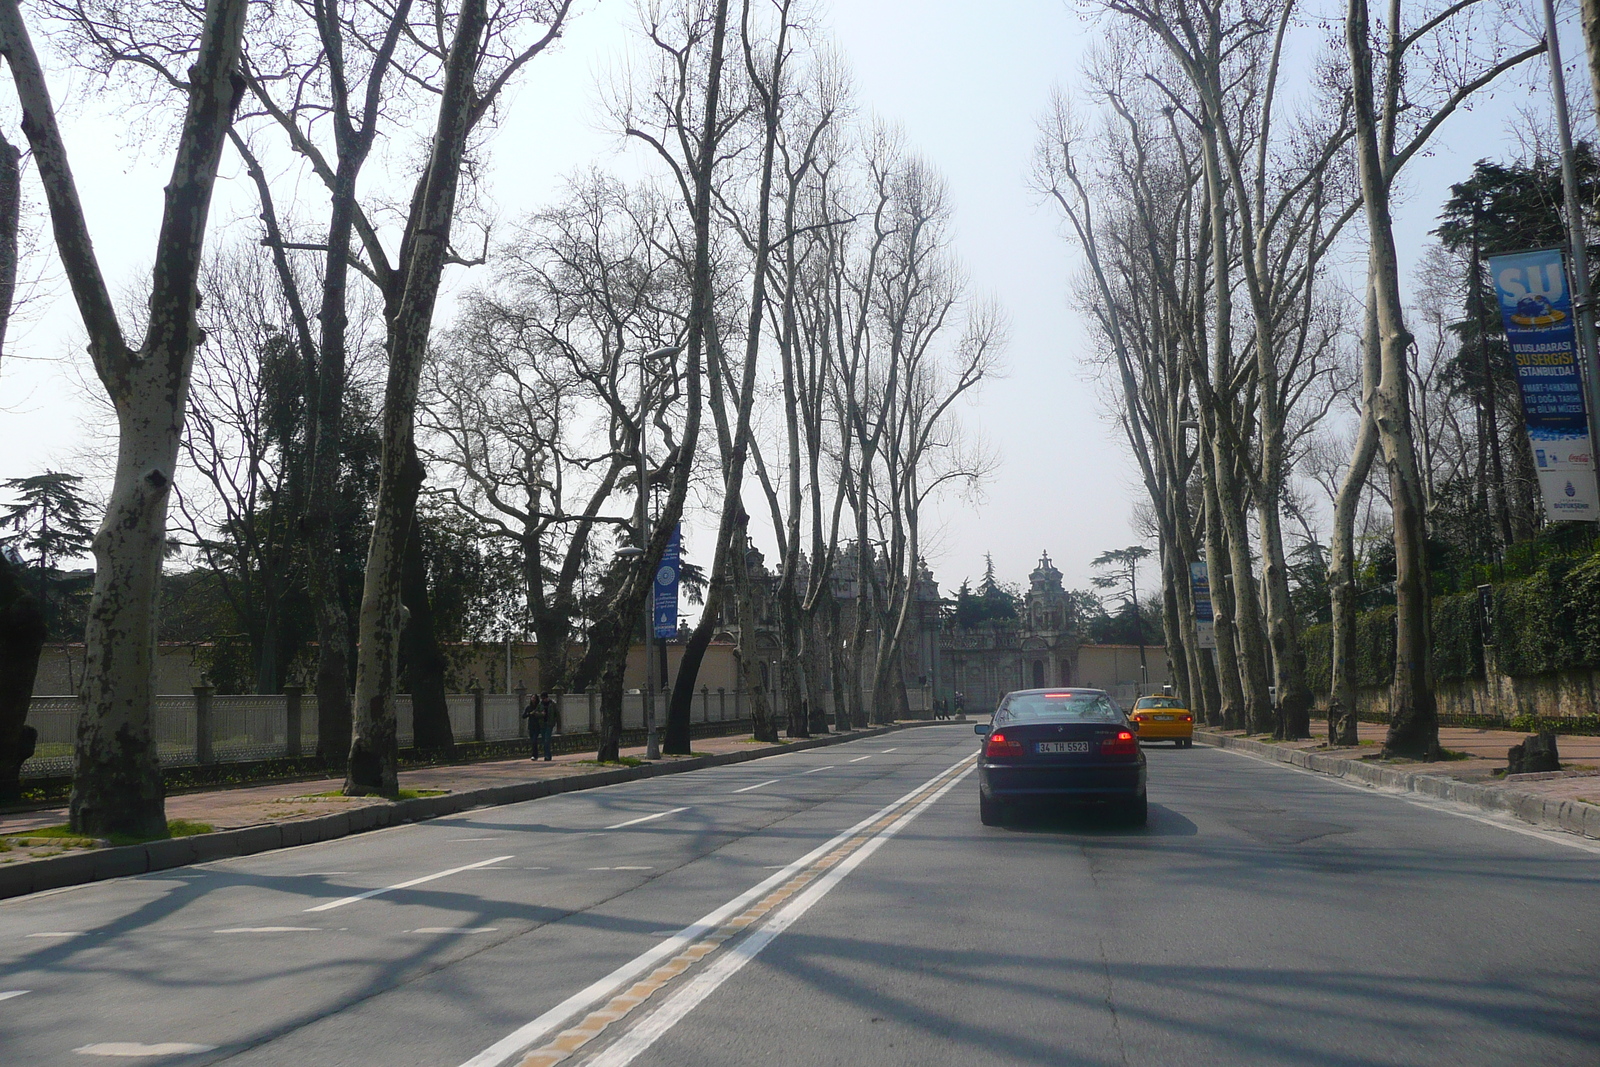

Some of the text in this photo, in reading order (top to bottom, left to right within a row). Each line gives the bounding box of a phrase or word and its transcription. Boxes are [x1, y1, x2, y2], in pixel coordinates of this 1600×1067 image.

[1498, 264, 1562, 307] SU
[1513, 341, 1571, 352] ULUSLARARASI
[1516, 353, 1530, 366] SU
[1040, 742, 1087, 752] 34 TH 5523
